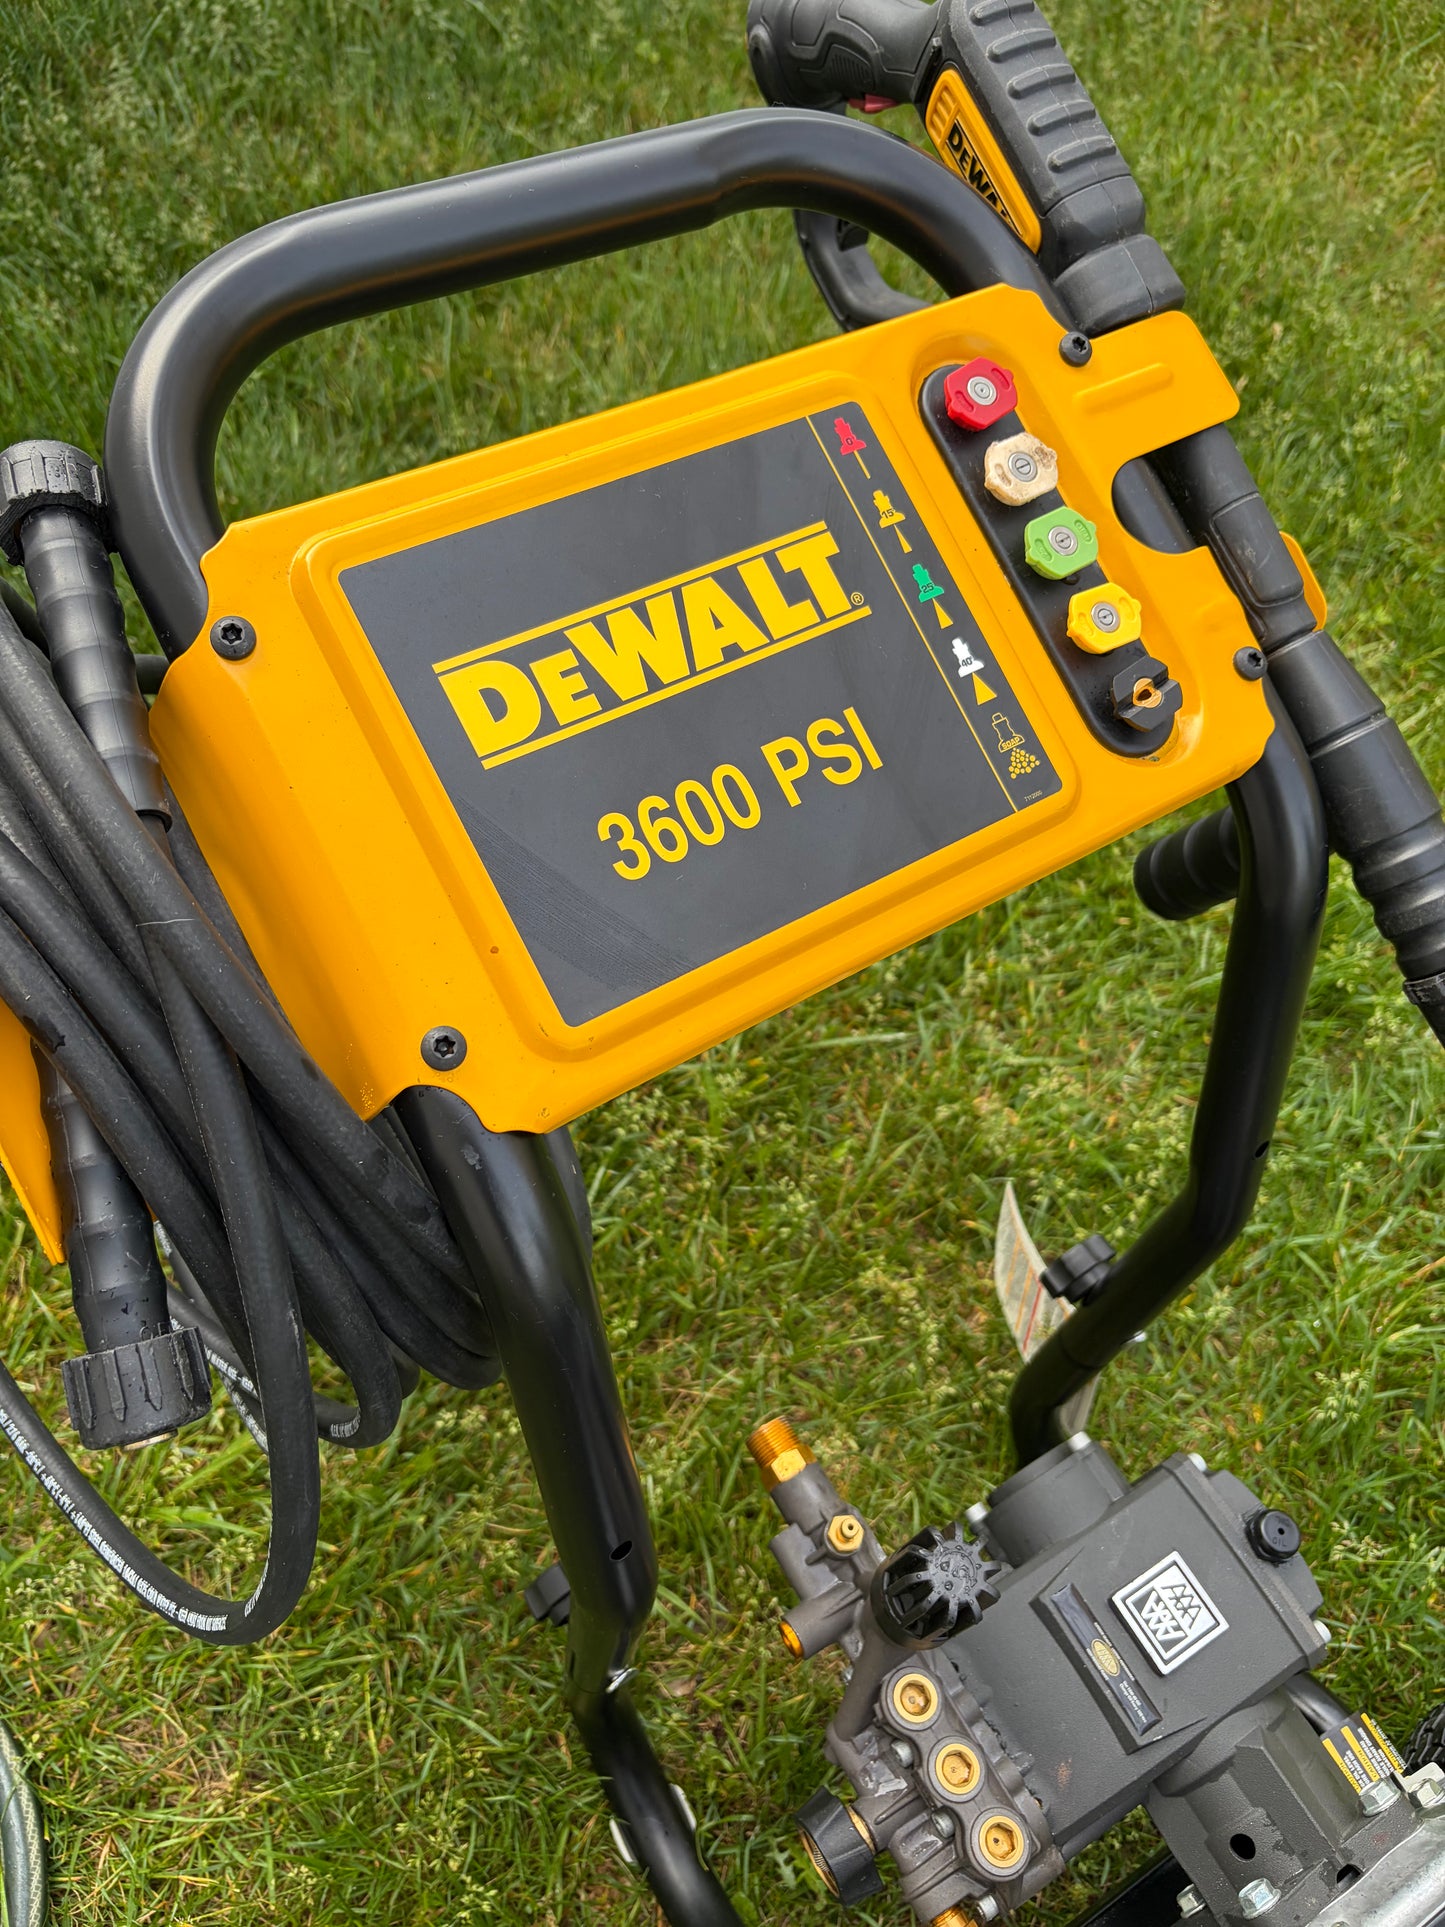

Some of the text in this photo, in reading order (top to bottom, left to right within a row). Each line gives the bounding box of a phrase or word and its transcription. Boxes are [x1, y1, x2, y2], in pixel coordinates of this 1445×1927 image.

[947, 119, 1008, 218] DEWA
[437, 530, 852, 758] DEWALT
[596, 706, 884, 881] 3600 PSI
[1001, 736, 1020, 750] SOAP
